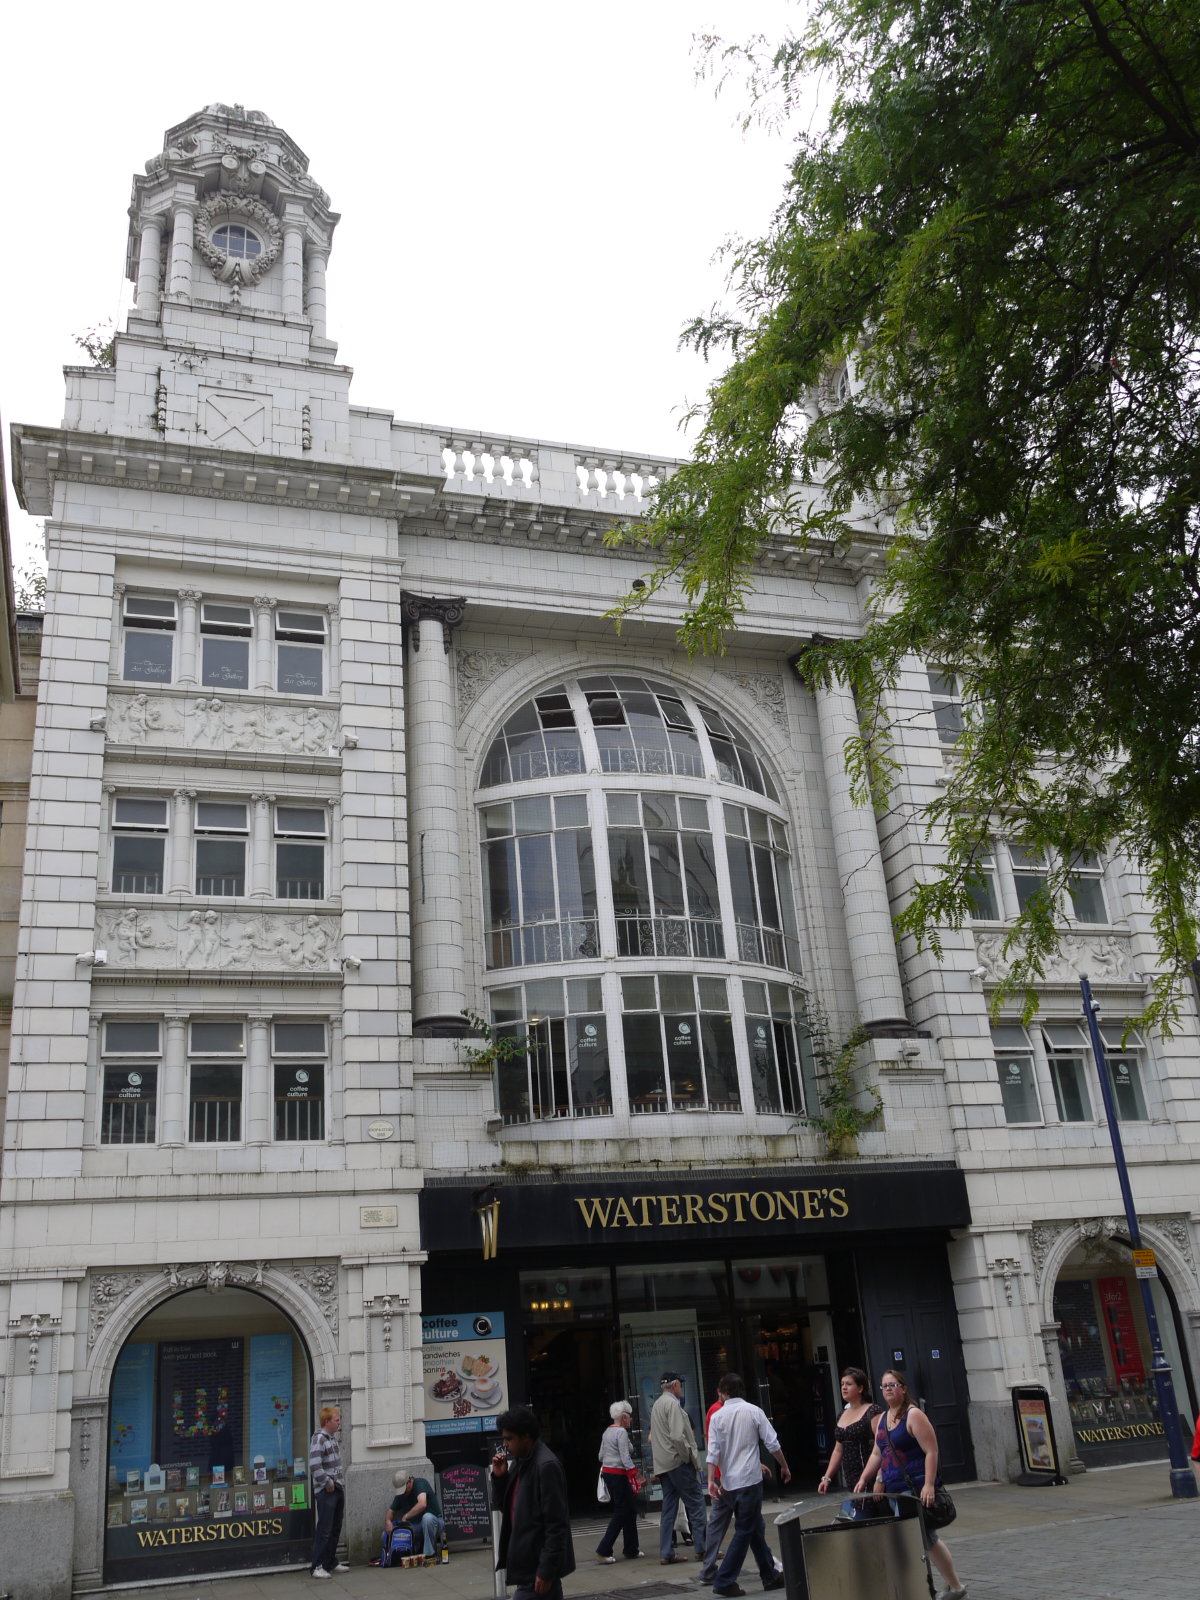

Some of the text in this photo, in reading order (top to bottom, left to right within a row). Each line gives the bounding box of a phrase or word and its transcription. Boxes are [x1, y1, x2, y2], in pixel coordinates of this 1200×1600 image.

[144, 666, 167, 675] Gallery
[222, 672, 244, 680] Gallery
[297, 678, 318, 687] Gallery
[574, 1188, 850, 1229] WATERSTONE'S
[422, 1317, 458, 1329] coffee
[421, 1344, 443, 1352] coffee
[1077, 1422, 1165, 1443] WATERSTONE
[137, 1518, 283, 1548] WATERSTONE'S
